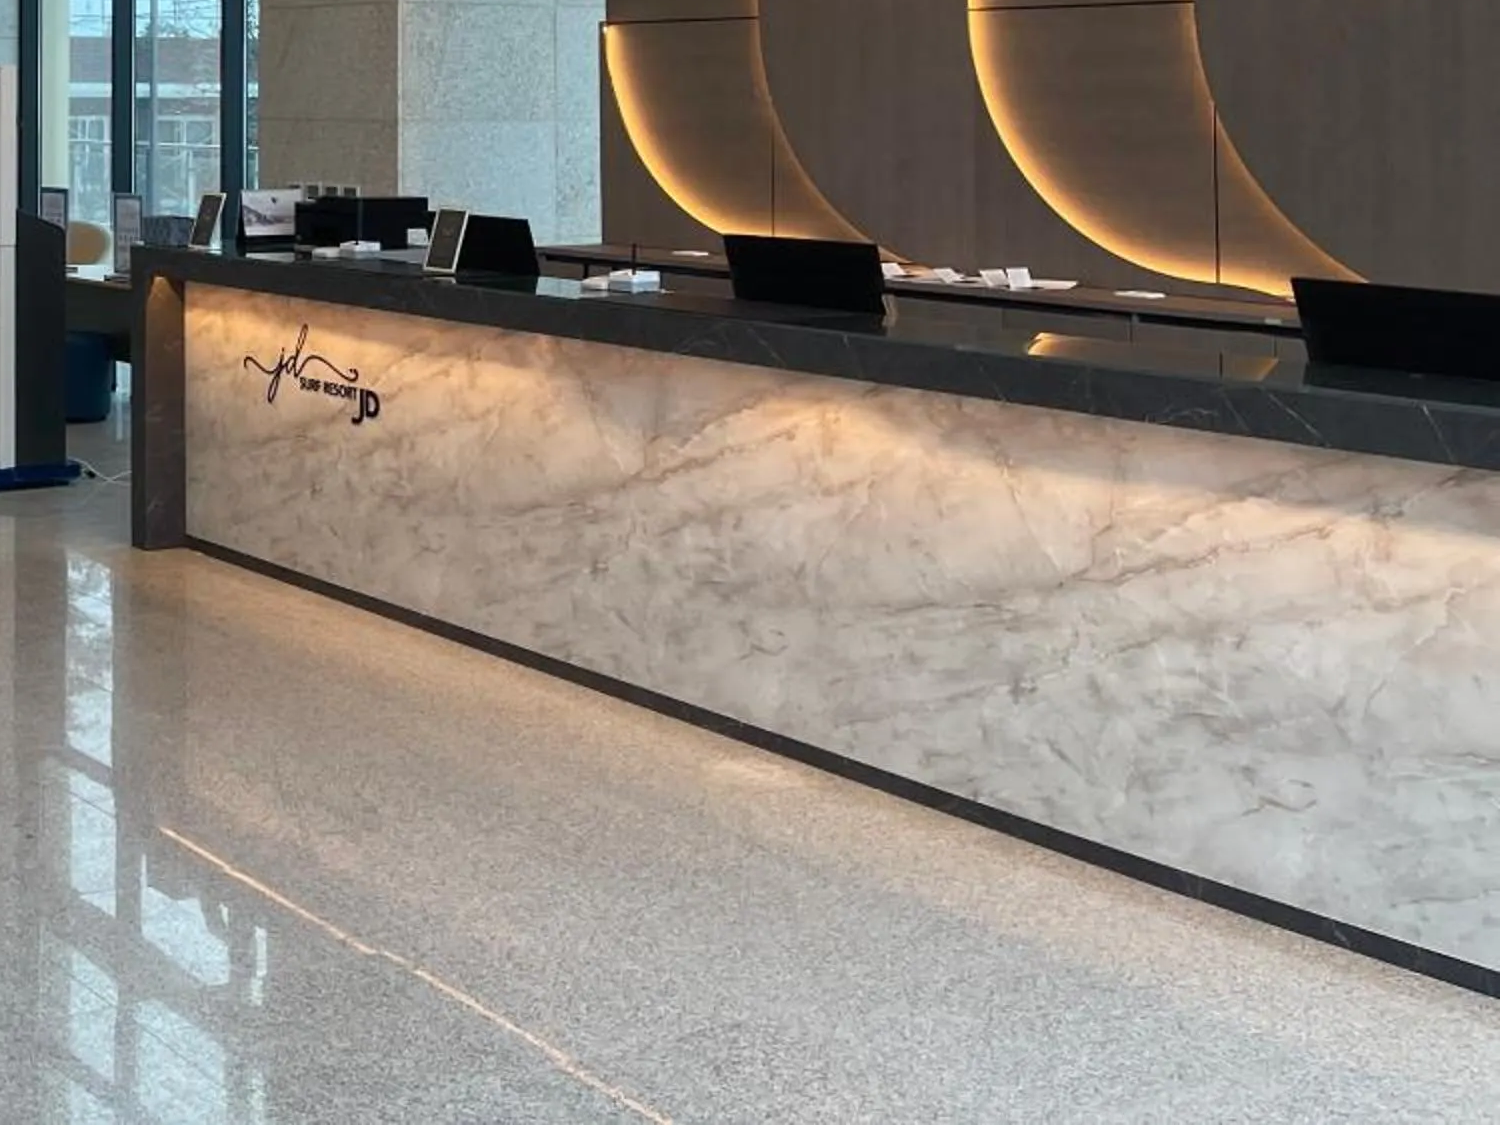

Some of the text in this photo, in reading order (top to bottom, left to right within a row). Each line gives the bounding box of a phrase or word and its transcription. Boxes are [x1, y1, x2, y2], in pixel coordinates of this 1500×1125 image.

[299, 376, 381, 425] SURF RESORT JD
